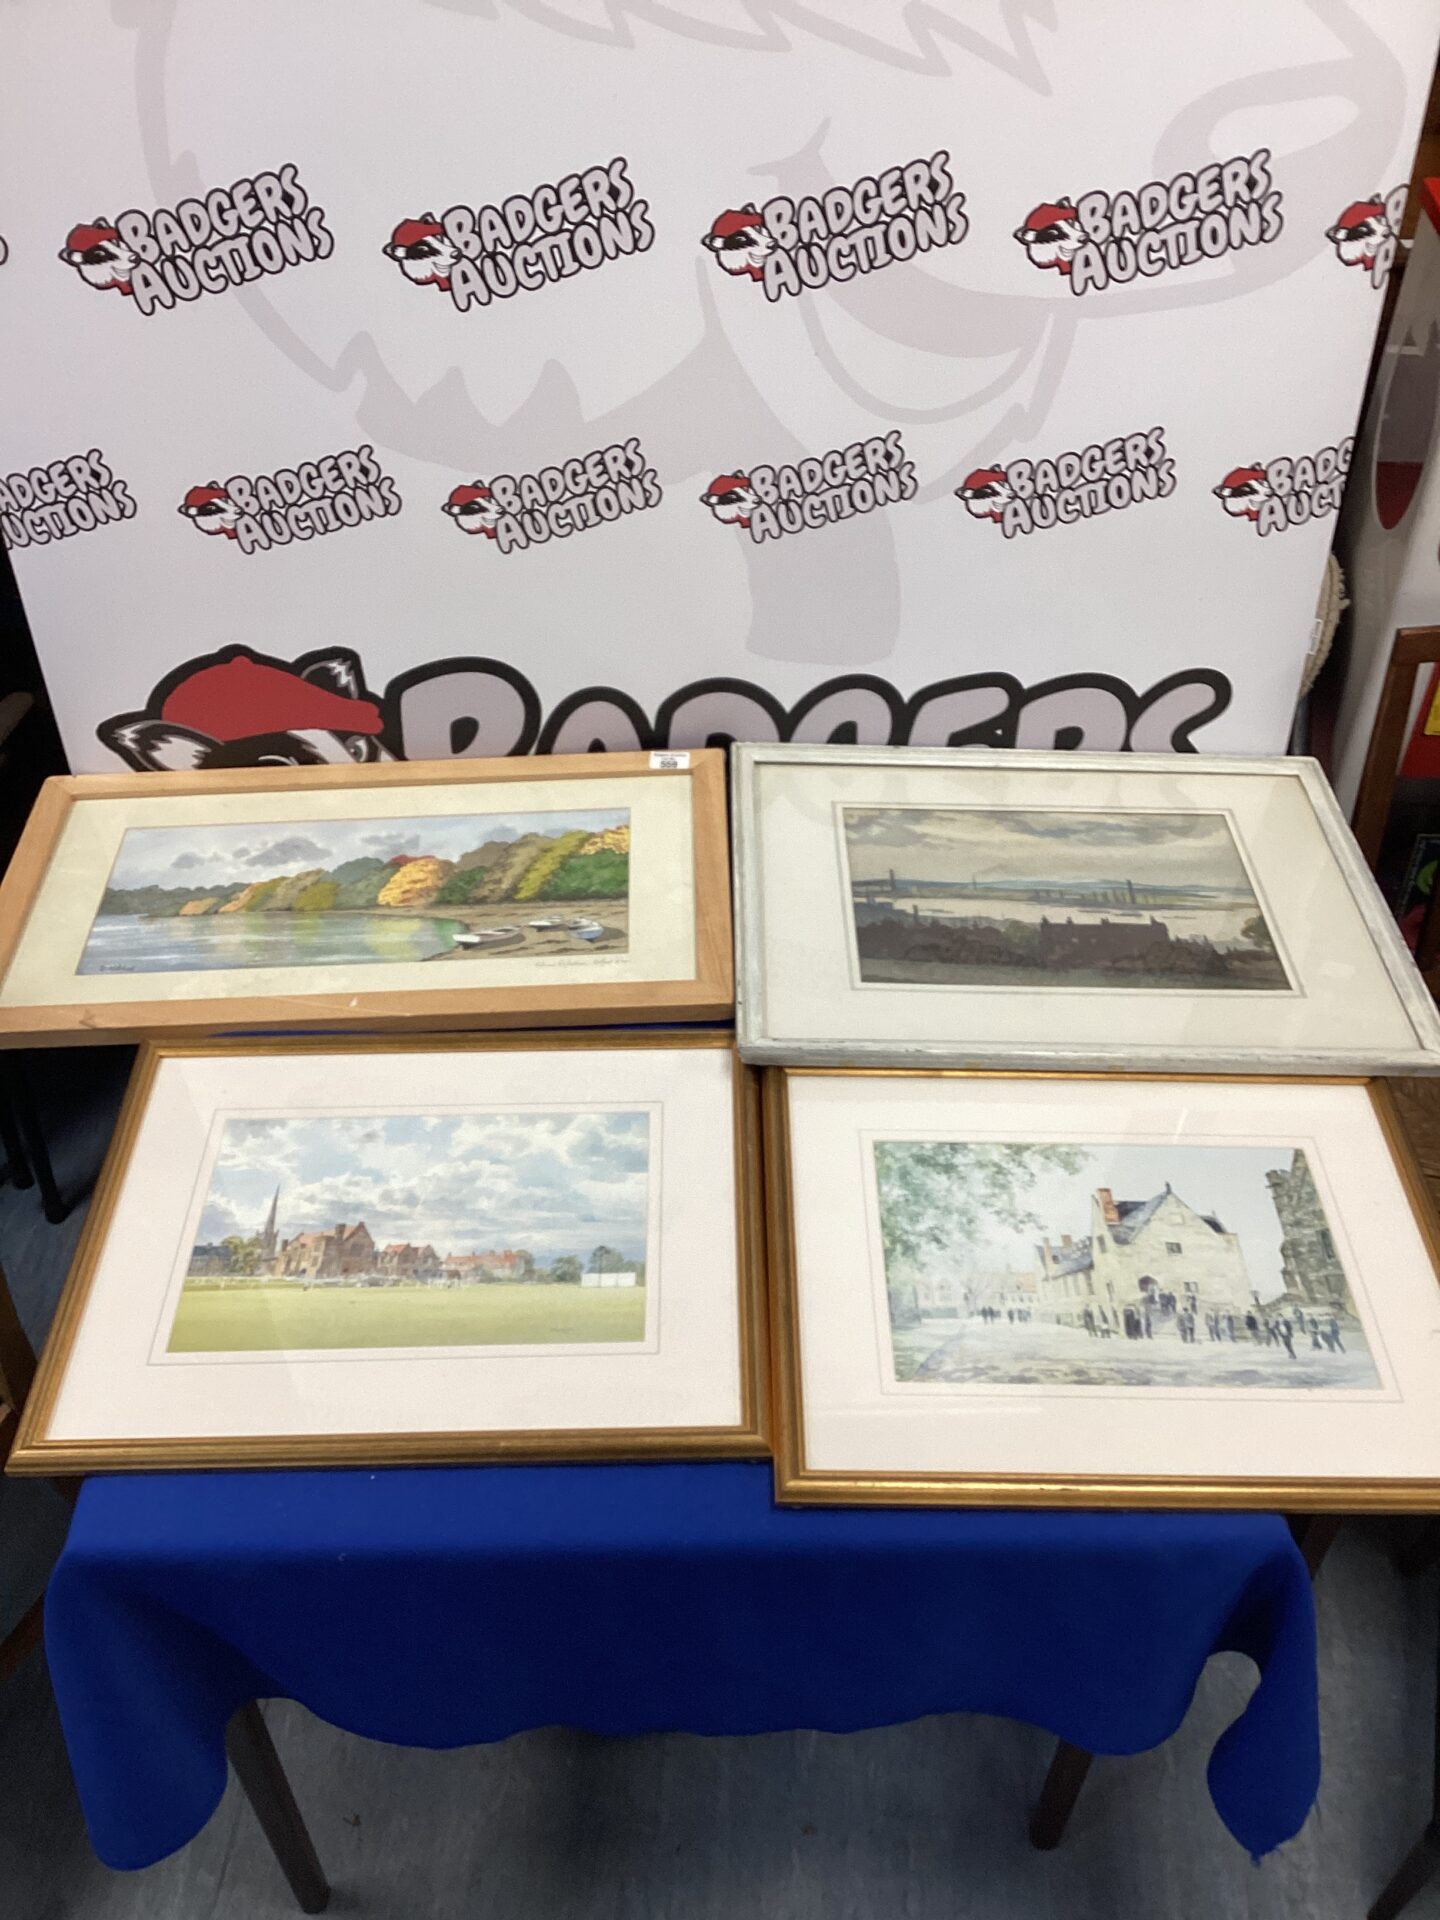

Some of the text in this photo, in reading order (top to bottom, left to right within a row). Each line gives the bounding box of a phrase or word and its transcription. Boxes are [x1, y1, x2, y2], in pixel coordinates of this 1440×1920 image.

[115, 163, 309, 264] BADGERS
[441, 156, 634, 260] BADGERS
[762, 150, 953, 250] BADGERS
[1076, 148, 1272, 244] BADGERS
[131, 207, 335, 316] AUCTIONS
[450, 199, 655, 312] AUCTIONS
[763, 192, 969, 302] AUCTIONS
[1070, 191, 1283, 296] AUCTIONS
[225, 444, 381, 516] BADGERS
[489, 437, 645, 515] BADGERS
[749, 429, 905, 505] BADGERS
[750, 461, 918, 544] AUCTIONS
[1001, 458, 1177, 539] AUCTIONS
[1006, 426, 1166, 499] BADGERS
[235, 476, 402, 555] AUCTIONS
[496, 468, 663, 554] AUCTIONS
